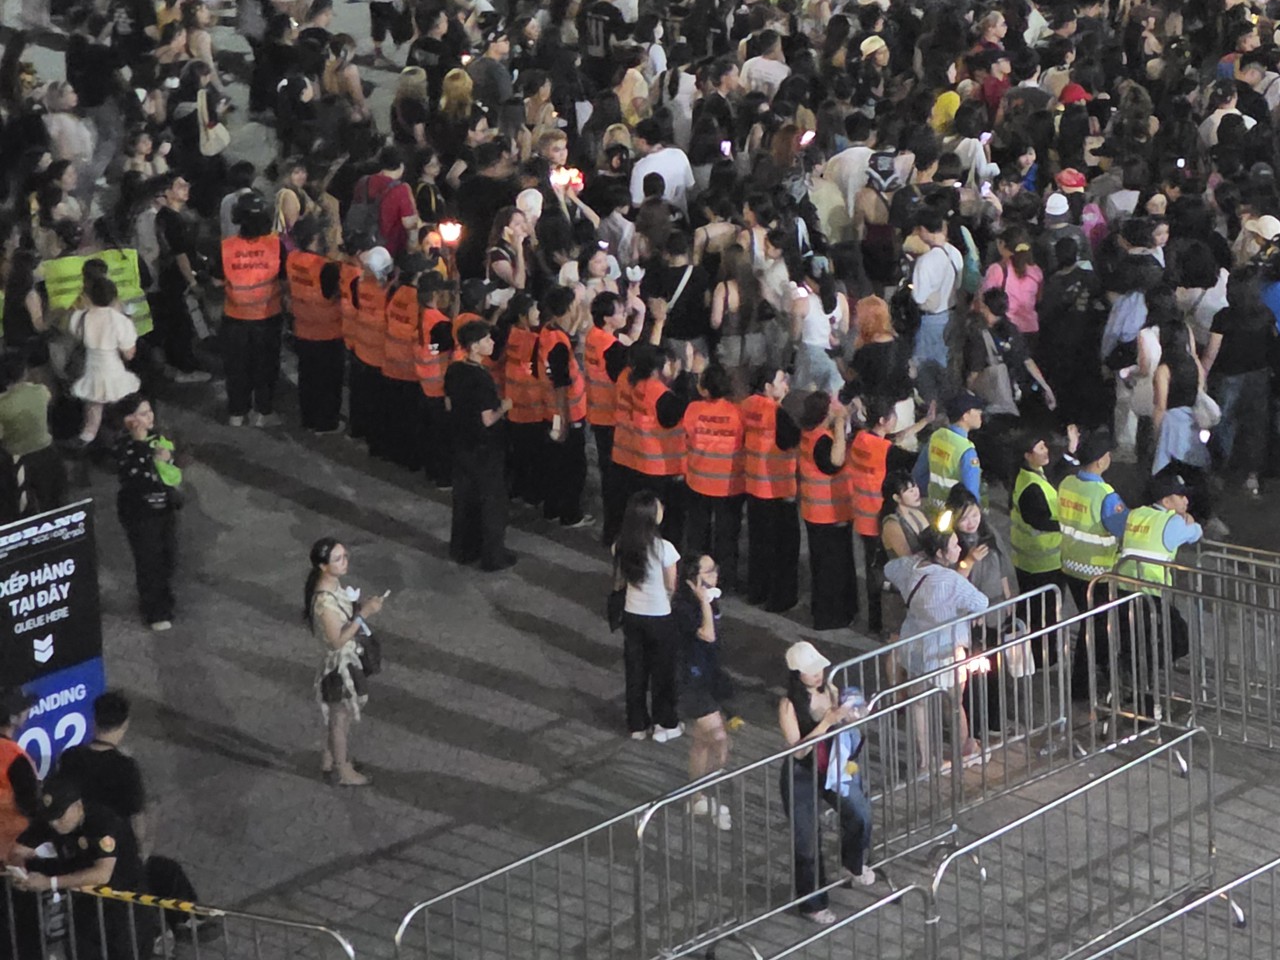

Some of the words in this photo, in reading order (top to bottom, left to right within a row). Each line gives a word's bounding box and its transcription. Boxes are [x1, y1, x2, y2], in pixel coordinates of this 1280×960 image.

[0, 570, 29, 598] XẾP
[30, 558, 75, 587] HÀNG
[8, 594, 36, 617] TẠI
[36, 582, 71, 608] ĐÂY
[14, 614, 46, 634] QUEUE
[45, 606, 70, 624] HERE
[17, 712, 87, 781] 02
